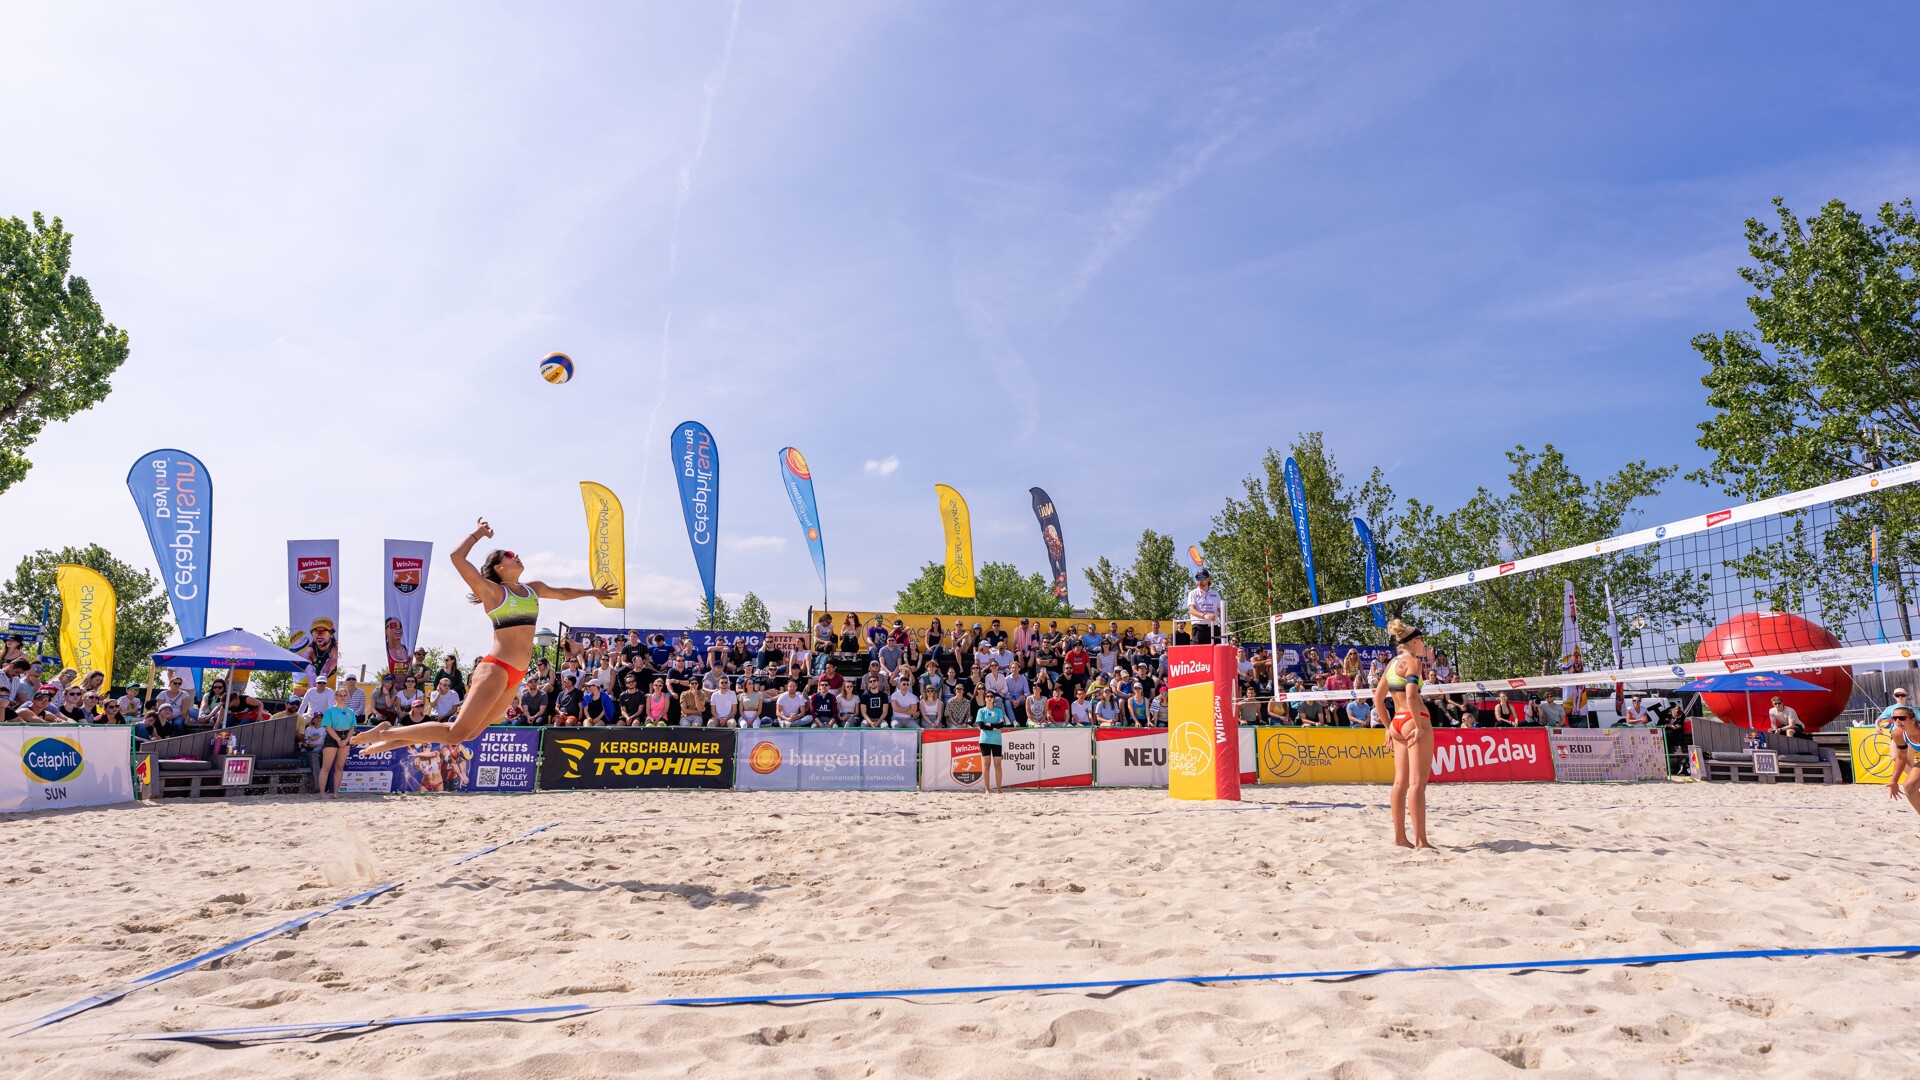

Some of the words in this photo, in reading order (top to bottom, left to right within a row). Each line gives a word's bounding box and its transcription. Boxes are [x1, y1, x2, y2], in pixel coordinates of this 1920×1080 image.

[302, 560, 327, 568] win2day
[1170, 660, 1211, 678] win2day
[1728, 660, 1751, 671] win2day
[1214, 695, 1227, 745] win2day
[481, 733, 517, 742] JETZT
[480, 742, 528, 752] TICKETS
[600, 741, 720, 754] KERSCHBAUMER
[1008, 741, 1035, 750] Beach
[1569, 744, 1592, 754] EOD
[479, 753, 535, 763] SICHERN:
[789, 748, 906, 772] burgenland
[1052, 745, 1061, 766] PRO
[1170, 751, 1197, 761] BEACH
[1431, 736, 1537, 776] win2day
[28, 751, 77, 771] Cetaphil
[1170, 761, 1197, 771] CAMPS
[1300, 759, 1332, 767] AUSTRIA
[593, 757, 724, 776] TROPHIES
[1016, 763, 1035, 771] Tour
[44, 787, 67, 801] SUN
